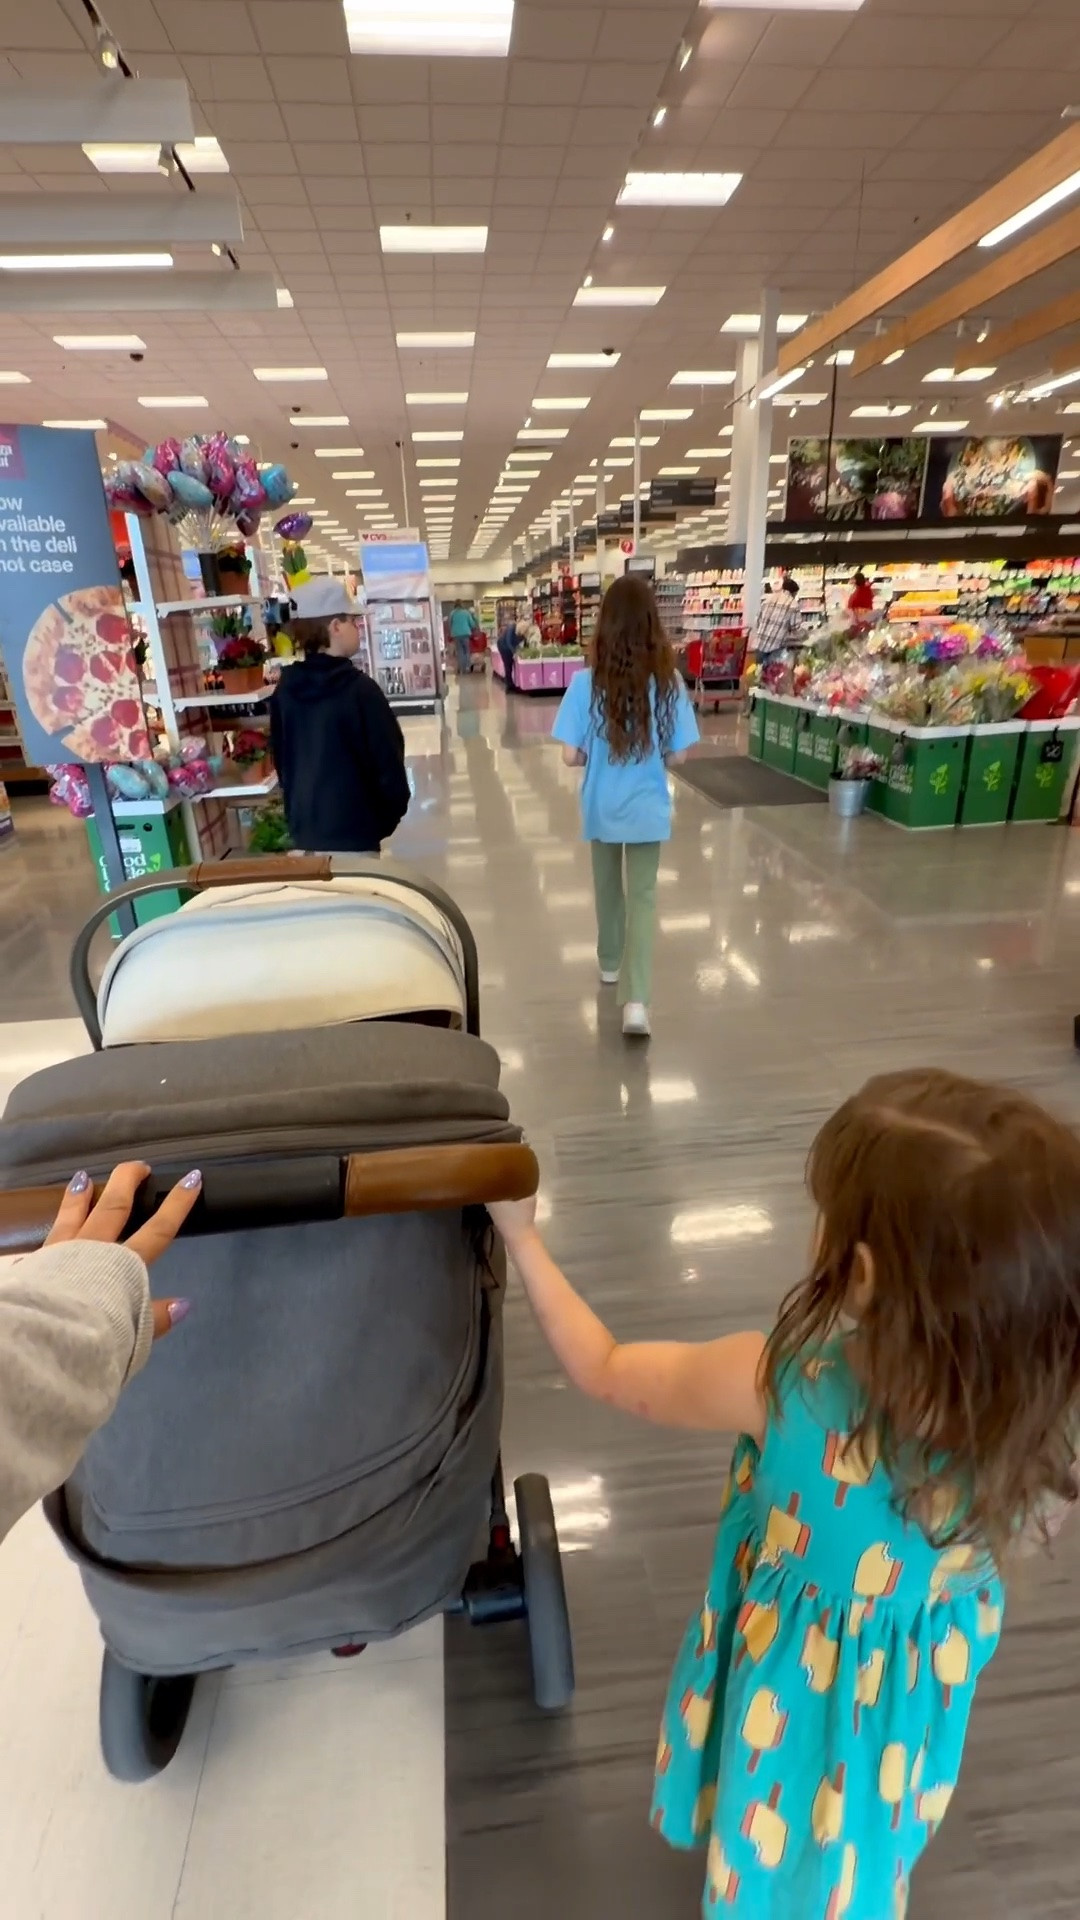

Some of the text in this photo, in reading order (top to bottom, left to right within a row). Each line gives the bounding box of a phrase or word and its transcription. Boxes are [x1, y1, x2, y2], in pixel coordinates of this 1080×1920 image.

[0, 498, 23, 511] ow
[0, 514, 66, 532] vailable
[11, 535, 42, 552] the
[45, 535, 77, 553] deli
[29, 559, 74, 573] case
